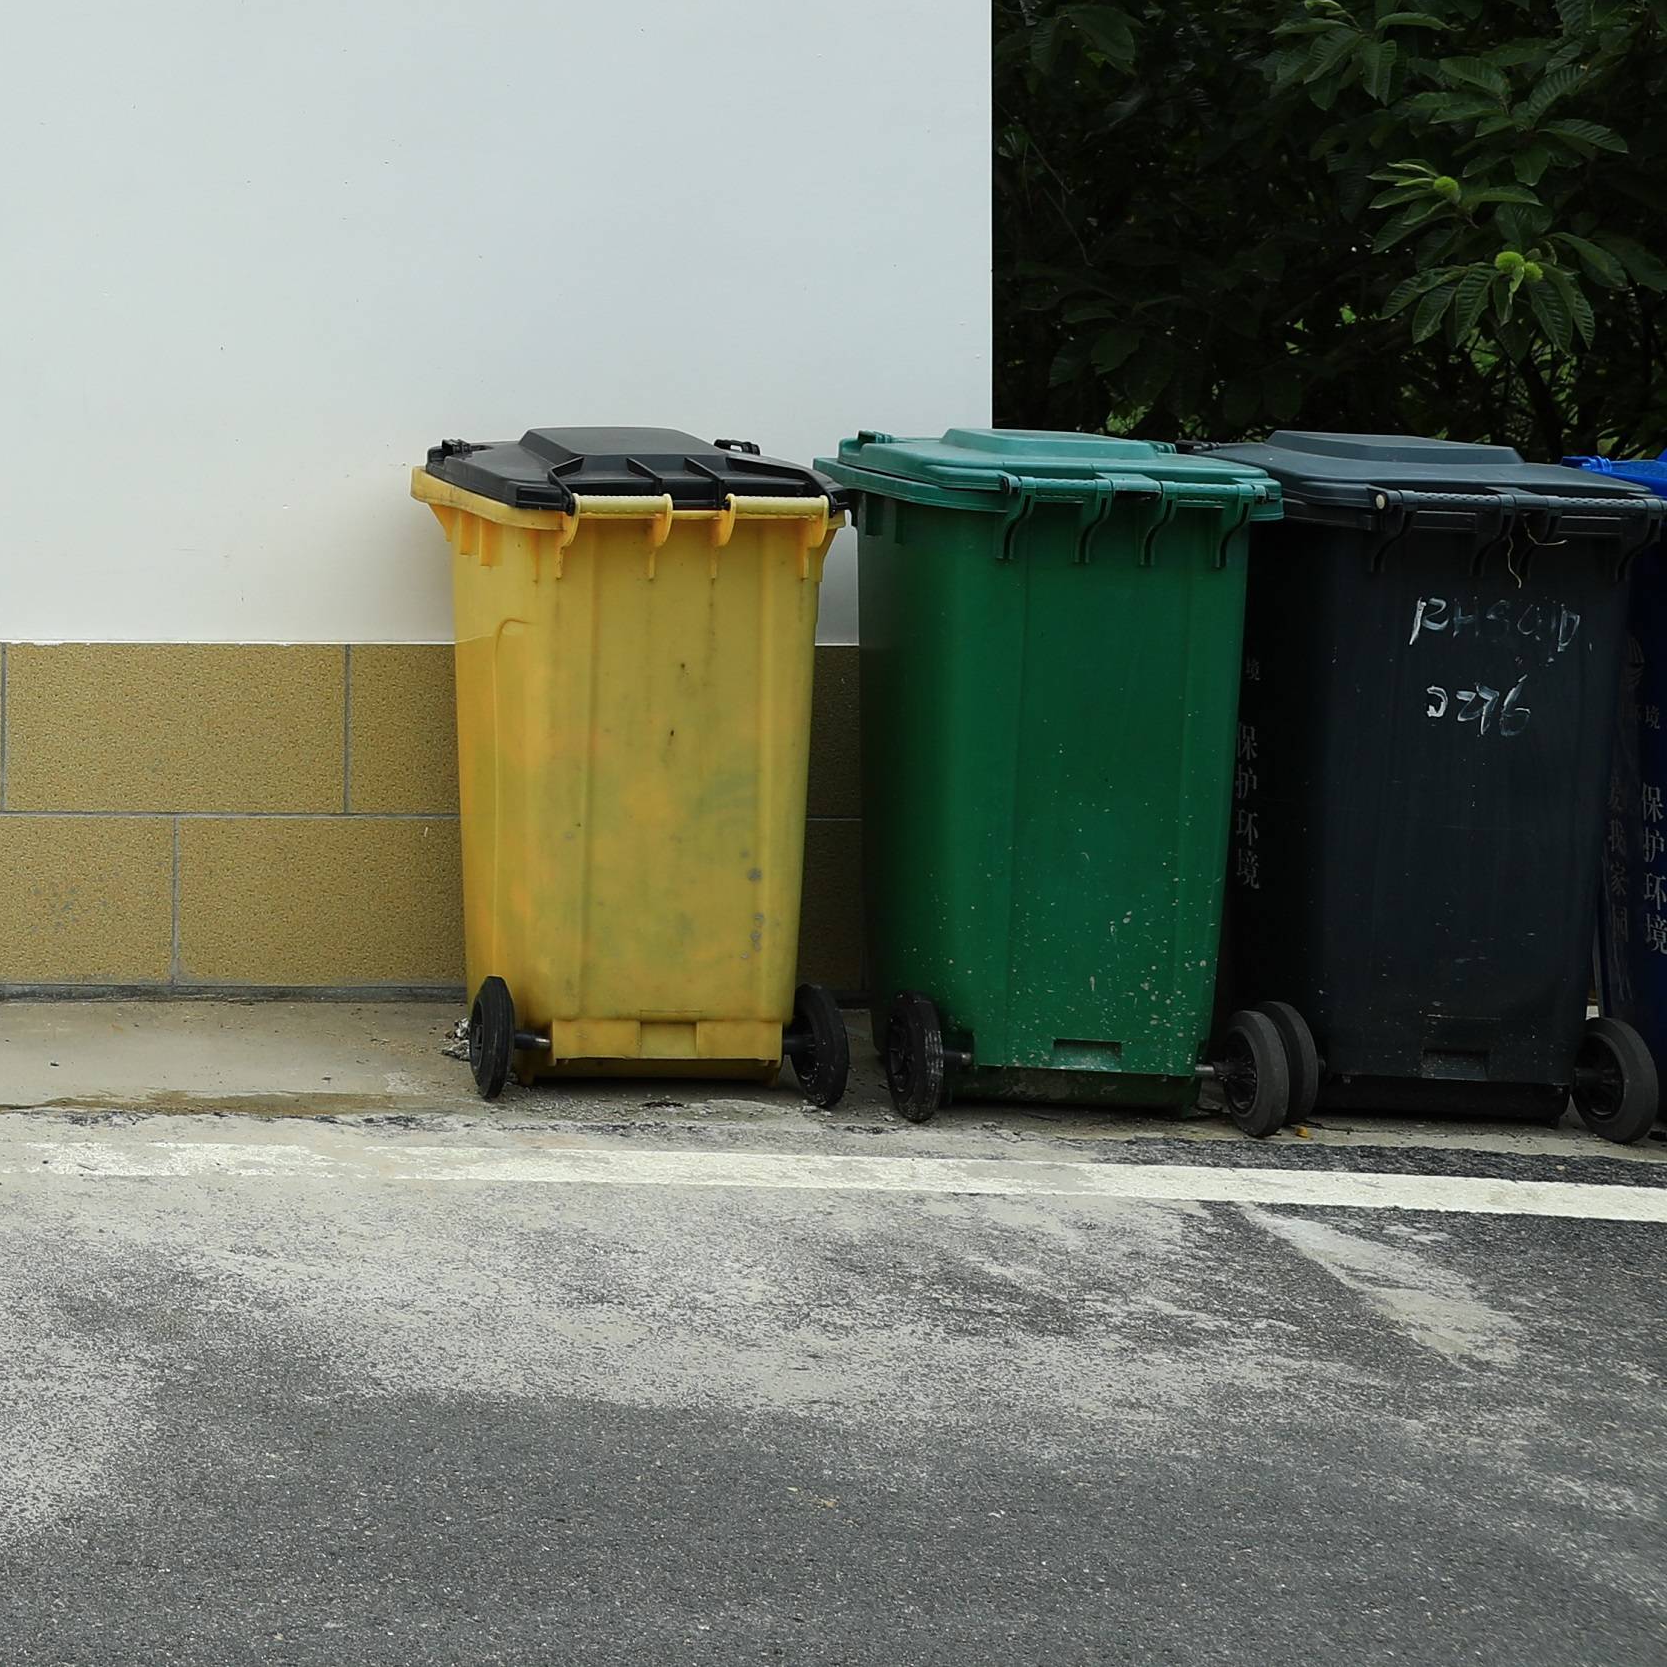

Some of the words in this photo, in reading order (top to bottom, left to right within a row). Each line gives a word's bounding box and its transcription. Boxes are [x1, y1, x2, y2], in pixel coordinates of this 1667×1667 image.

[1235, 721, 1260, 890] 保护环境
[1642, 782, 1667, 955] 保护环境
